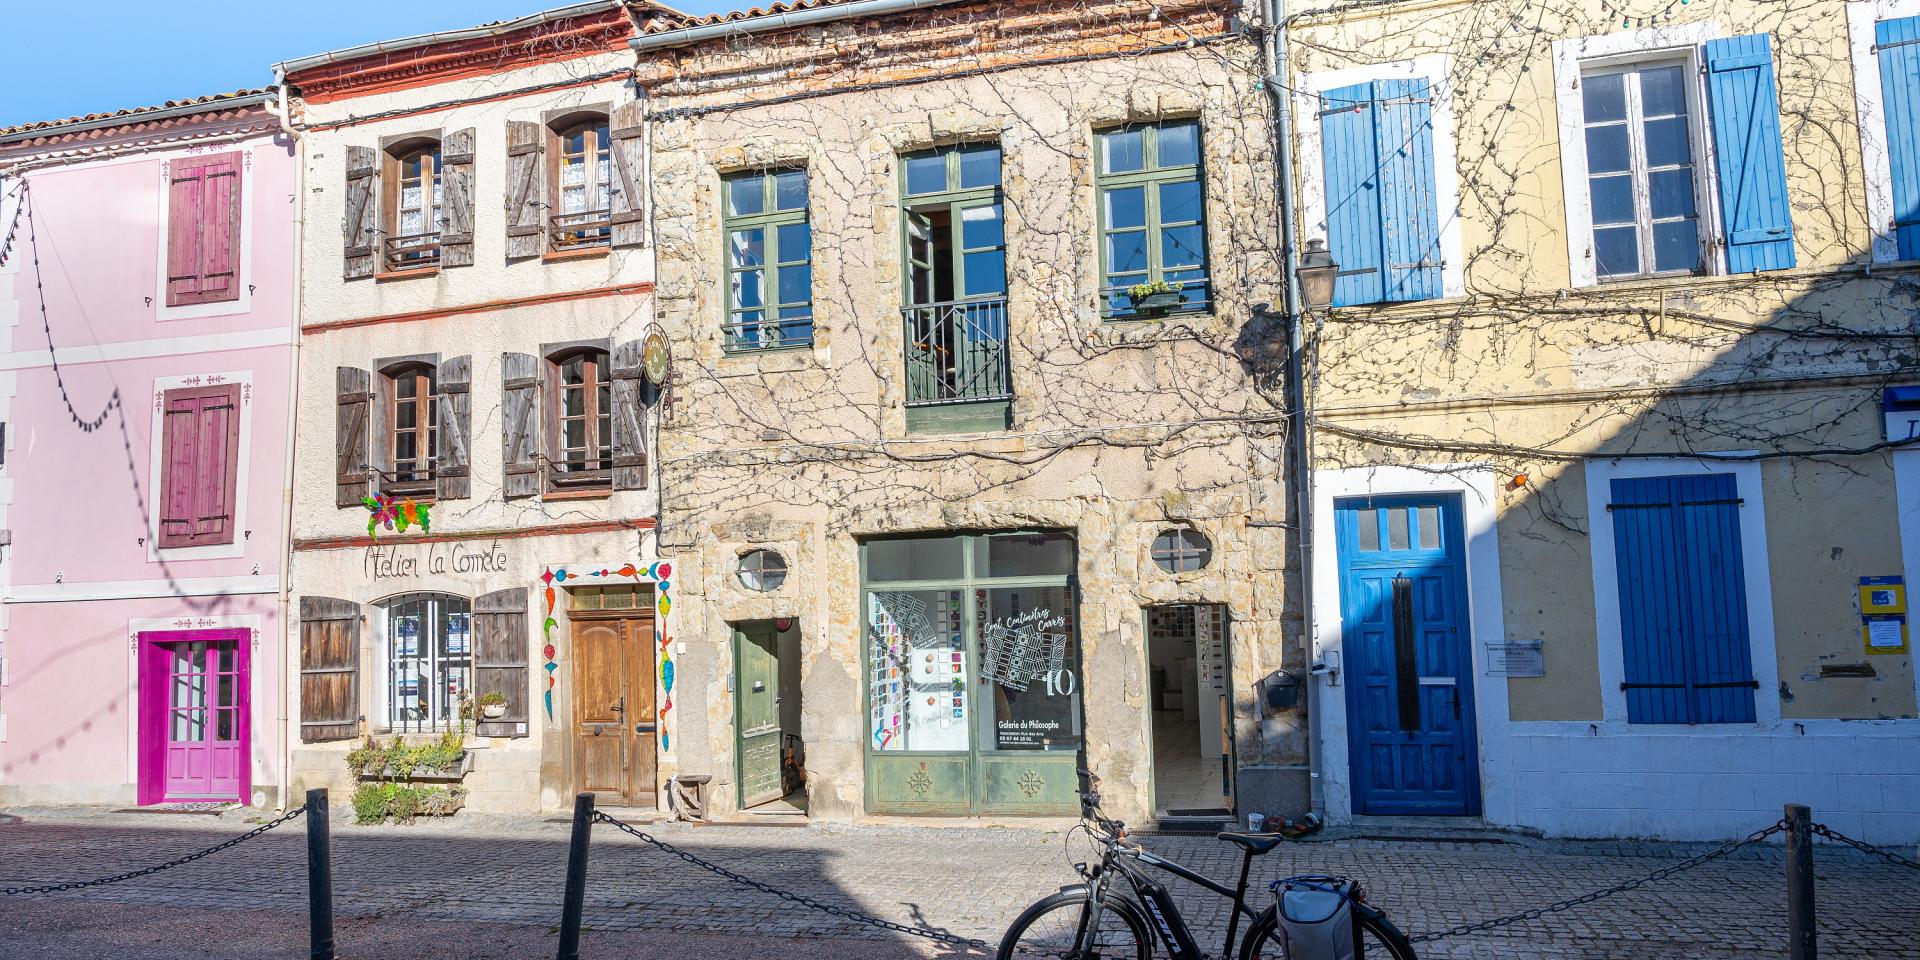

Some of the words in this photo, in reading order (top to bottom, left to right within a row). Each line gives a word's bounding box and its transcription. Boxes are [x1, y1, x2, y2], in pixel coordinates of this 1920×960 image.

[364, 543, 420, 582] Atelier
[984, 617, 1003, 634] Cent
[998, 719, 1020, 729] Galerie
[1020, 719, 1028, 729] du
[1028, 719, 1060, 731] Philosophe
